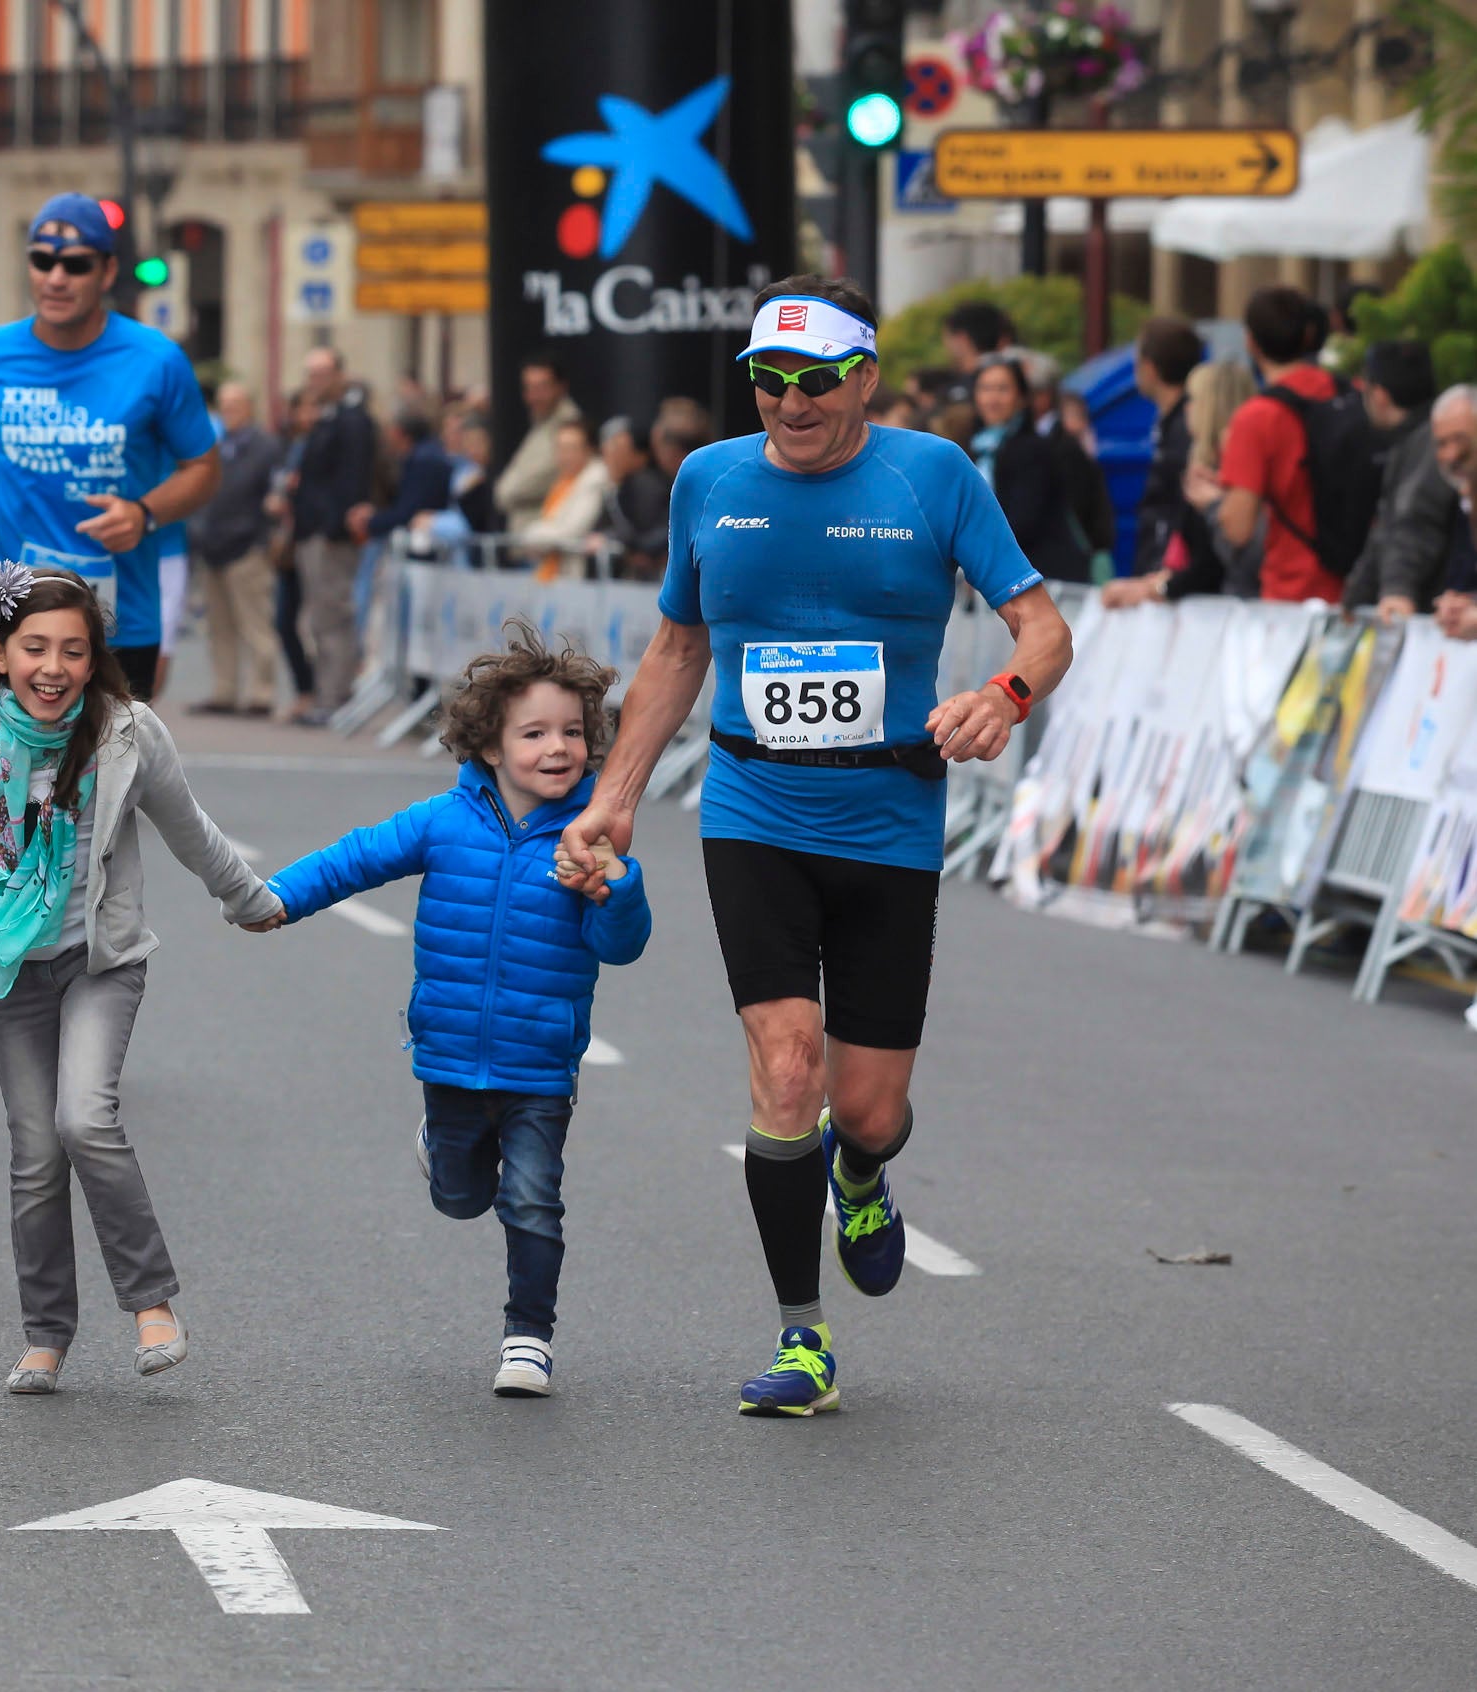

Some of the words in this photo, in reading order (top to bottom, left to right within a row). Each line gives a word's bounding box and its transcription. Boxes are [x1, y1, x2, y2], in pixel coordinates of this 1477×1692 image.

[0, 401, 88, 425] media
[2, 418, 127, 444] maratón
[826, 526, 865, 538] PEDRO
[870, 527, 913, 540] FERRER
[760, 652, 789, 661] media
[760, 657, 803, 668] maratón
[764, 680, 862, 725] 858
[779, 735, 809, 743] RIOJA
